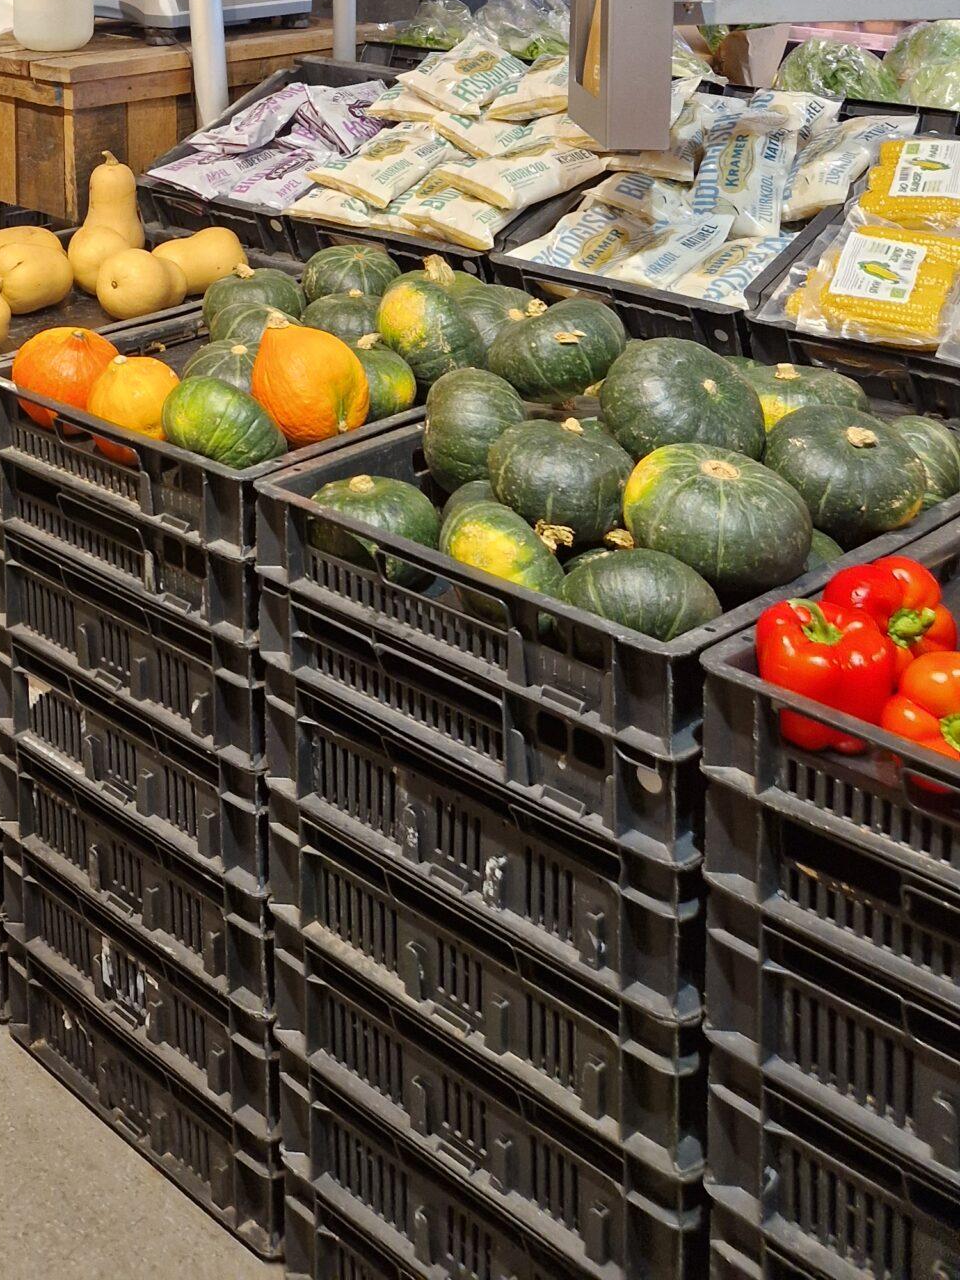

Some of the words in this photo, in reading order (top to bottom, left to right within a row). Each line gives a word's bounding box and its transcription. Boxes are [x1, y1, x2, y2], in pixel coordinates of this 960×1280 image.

[725, 133, 750, 187] KRAMER
[579, 227, 625, 268] KRAMER
[680, 223, 719, 250] NATUREL
